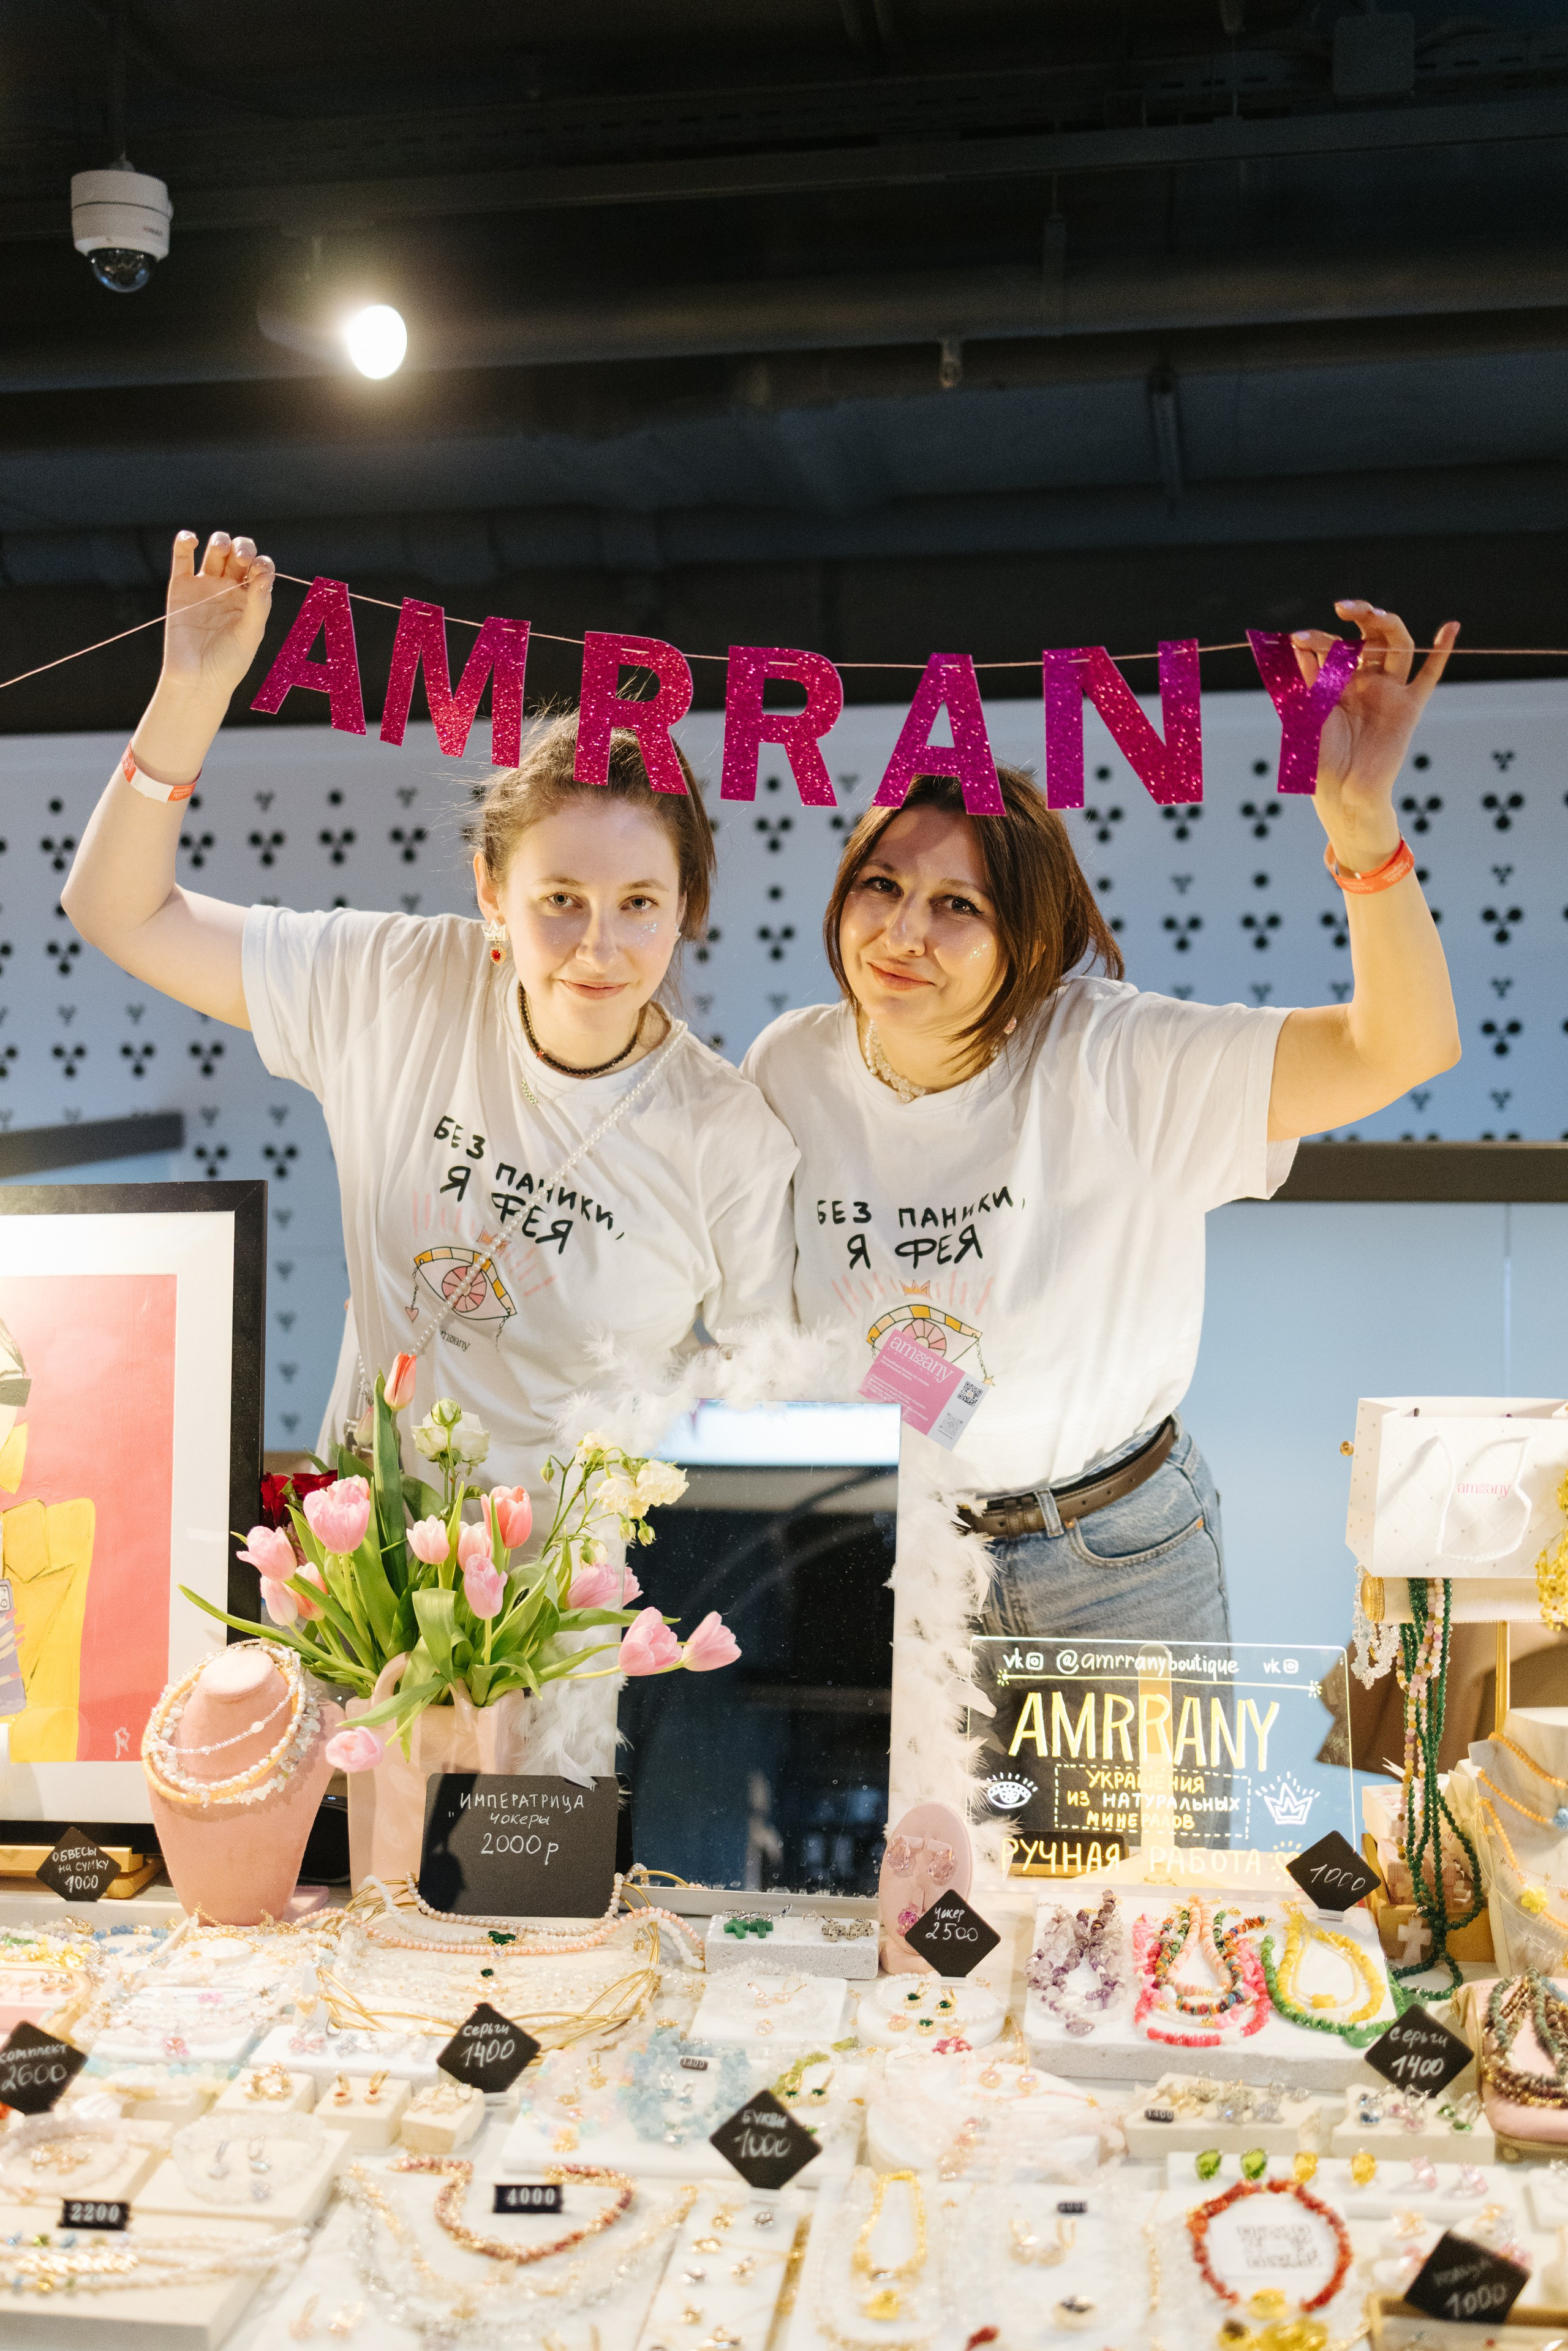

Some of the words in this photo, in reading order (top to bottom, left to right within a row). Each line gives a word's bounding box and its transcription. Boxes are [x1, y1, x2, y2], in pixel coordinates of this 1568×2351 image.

[250, 576, 1366, 816] AMRRANY
[434, 1115, 486, 1160] БЕЗ
[440, 1166, 471, 1202] Я
[491, 1192, 573, 1255] ФЕЯ
[817, 1199, 872, 1225] БЕЗ
[898, 1186, 1025, 1229] ПАНИКИ,
[847, 1233, 871, 1269] Я
[895, 1223, 983, 1269] ФЕЯ
[1003, 1648, 1023, 1669] vk
[1263, 1659, 1281, 1674] vk
[1008, 1691, 1280, 1772] AMRRANY
[1087, 1769, 1205, 1795] УКРАШЕНИЯ
[1067, 1791, 1090, 1808] ИЗ
[1102, 1792, 1241, 1812] НАТУРАЛЬНЫХ
[1087, 1814, 1195, 1831] МИНЕРАЛОВ
[52, 1846, 97, 1862] ОБВЕСЫ
[1001, 1836, 1121, 1875] РУЧНАЯ
[1150, 1845, 1261, 1875] РАБОТА
[64, 1875, 99, 1893] 1000
[1310, 1863, 1366, 1890] 1000
[925, 1922, 978, 1941] 2500
[460, 2039, 514, 2067] 1400
[1392, 2055, 1444, 2078] 1400
[1, 2063, 67, 2091] 2600
[507, 2187, 555, 2206] 4000
[70, 2202, 120, 2223] 2200
[1444, 2282, 1507, 2318] 1000
